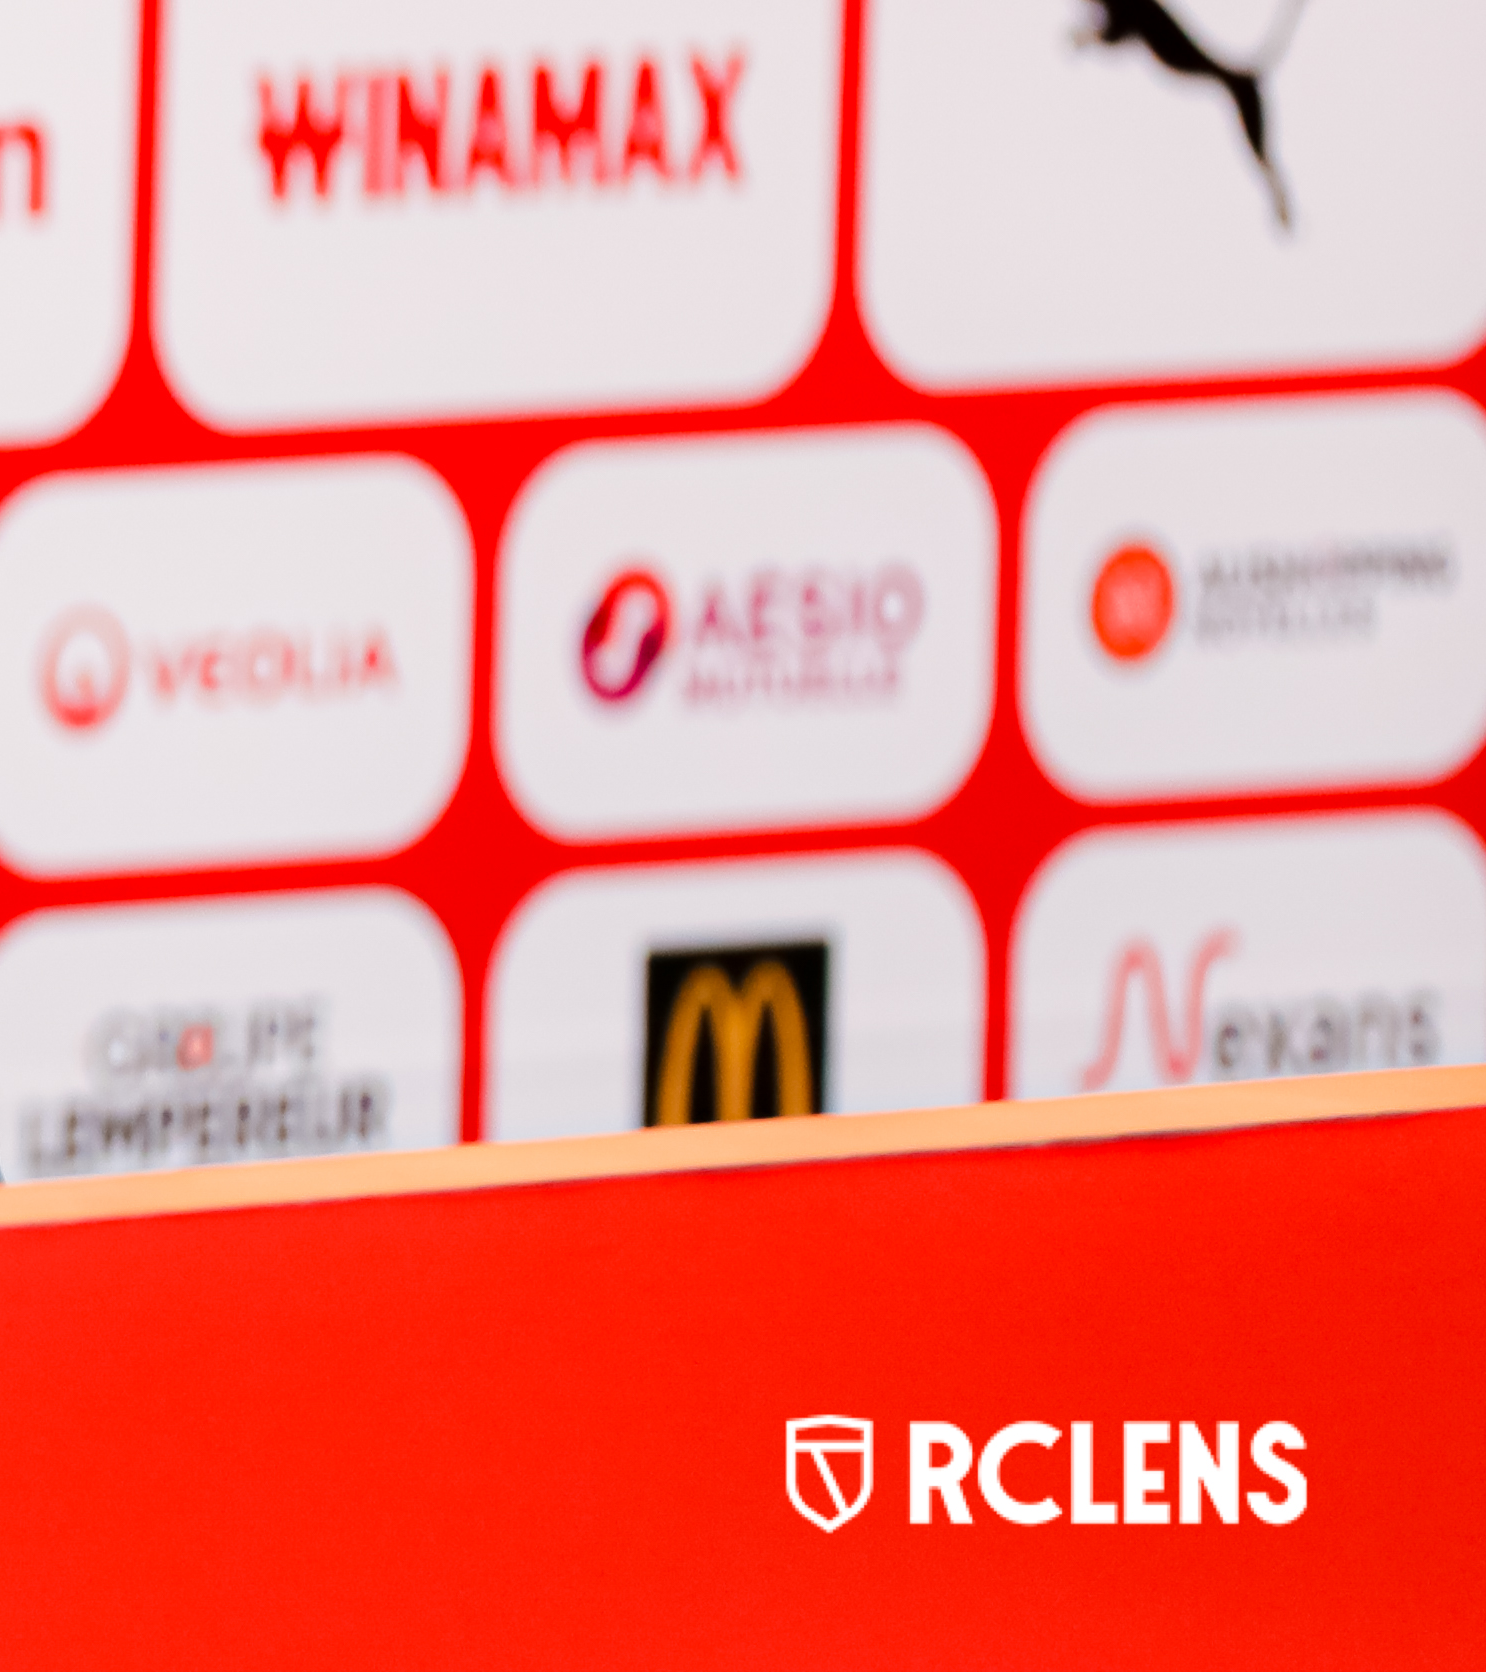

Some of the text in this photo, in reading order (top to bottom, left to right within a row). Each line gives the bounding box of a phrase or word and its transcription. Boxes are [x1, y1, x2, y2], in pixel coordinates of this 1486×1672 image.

[256, 56, 743, 202] WINAMAX
[145, 628, 399, 705] VEOLIA
[1084, 928, 1440, 1080] Nexans
